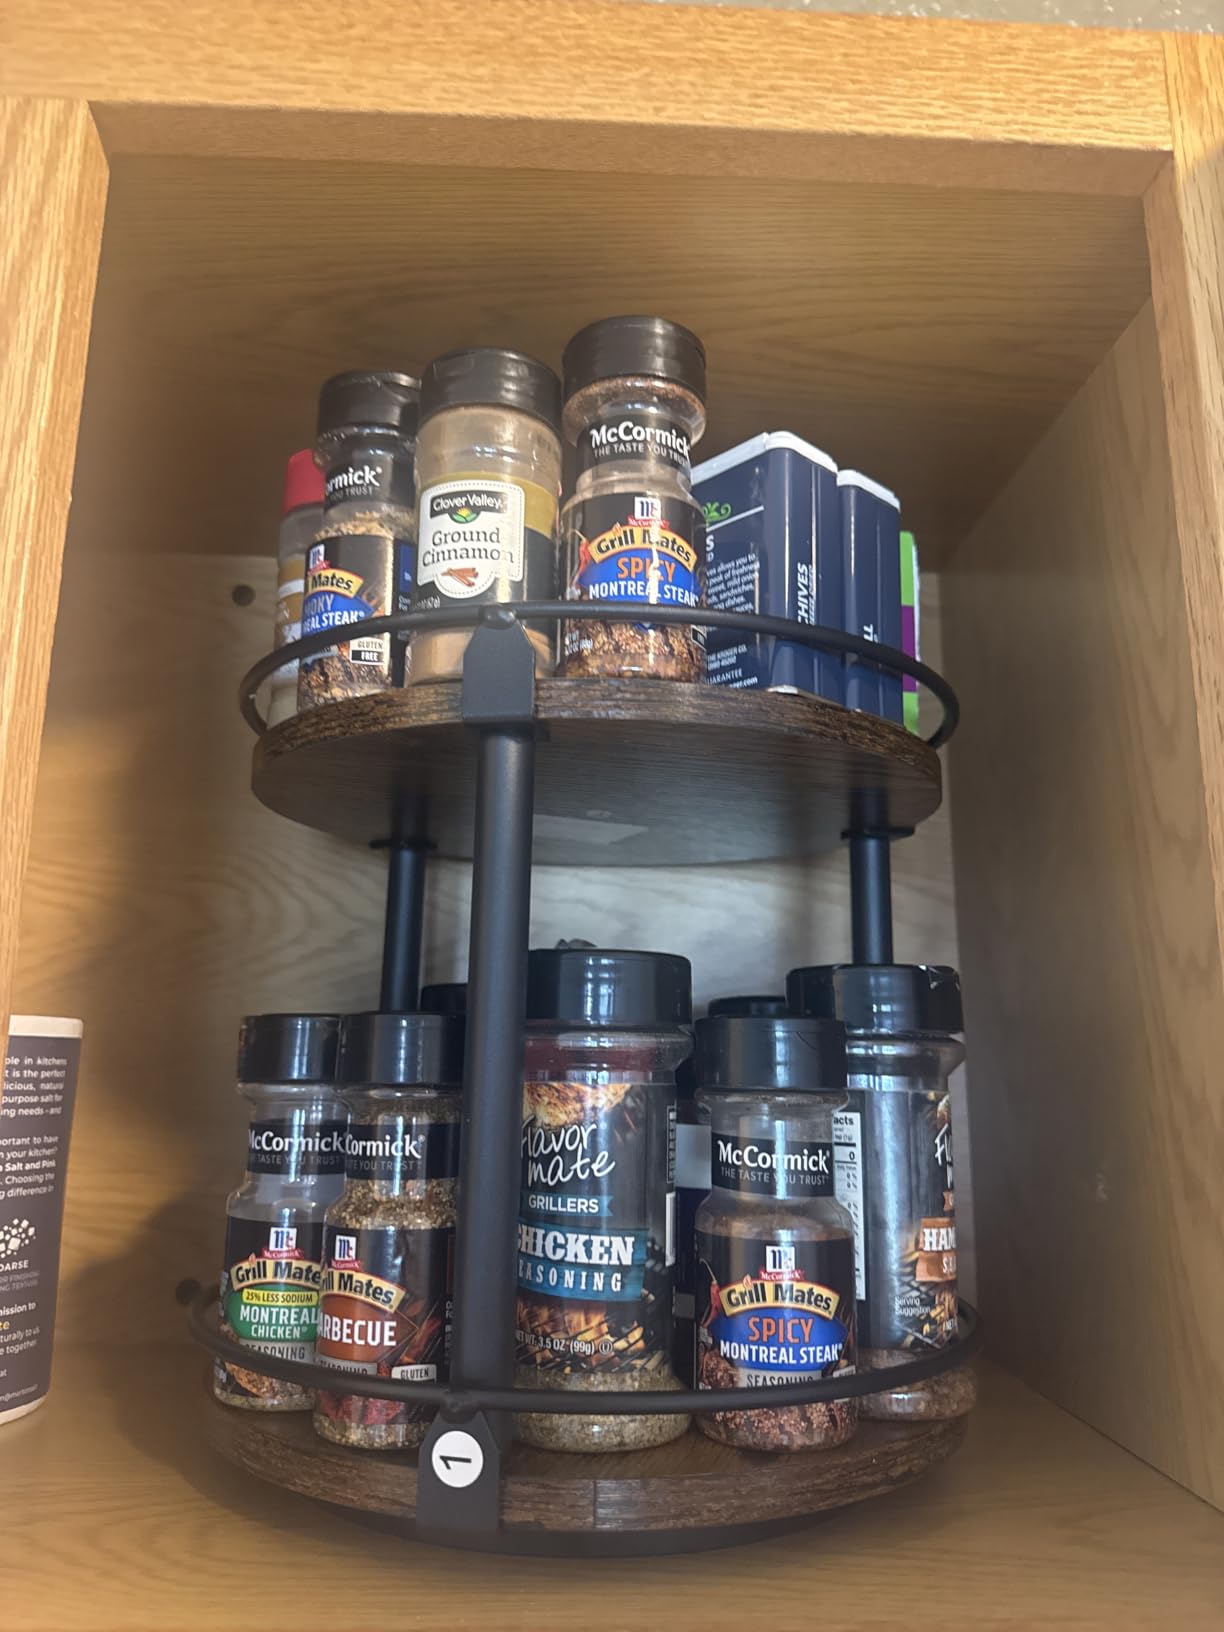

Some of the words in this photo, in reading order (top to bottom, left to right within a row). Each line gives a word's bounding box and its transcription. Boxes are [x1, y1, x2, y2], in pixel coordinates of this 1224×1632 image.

[590, 421, 691, 458] McCormick
[612, 443, 645, 453] TASTE
[433, 496, 467, 511] Clover
[468, 493, 503, 509] Valley
[432, 528, 501, 547] Ground
[597, 528, 634, 554] Grill
[642, 529, 691, 563] Mates
[421, 545, 514, 568] Cinnamon
[617, 557, 676, 583] SPICY
[312, 572, 353, 591] Mates
[589, 580, 661, 600] MONTREAL
[322, 610, 360, 628] STEAK
[361, 651, 379, 661] FREE
[24, 1056, 33, 1065] in
[13, 1068, 21, 1078] is
[23, 1069, 39, 1078] the
[2, 1095, 39, 1104] purpose
[19, 1107, 44, 1116] needs
[33, 1136, 41, 1144] to
[520, 1115, 598, 1158] Flavor
[6, 1150, 27, 1160] your
[718, 1140, 829, 1174] McCormick
[5, 1162, 23, 1171] Salt
[25, 1161, 41, 1170] and
[42, 1159, 56, 1168] Pink
[359, 1160, 377, 1170] YOU
[528, 1143, 616, 1188] mate
[5, 1173, 44, 1184] Choosing
[721, 1167, 736, 1178] THE
[738, 1168, 770, 1183] TASTE
[799, 1172, 826, 1185] TRUST
[7, 1186, 47, 1198] difference
[528, 1195, 599, 1213] GRILLERS
[235, 1260, 266, 1282] Grill
[273, 1261, 321, 1283] Mate
[519, 1259, 622, 1292] EASONING
[338, 1271, 393, 1304] Mates
[28, 1301, 36, 1311] to
[245, 1291, 261, 1301] 25%
[262, 1291, 279, 1303] LESS
[281, 1293, 313, 1303] SODIUM
[727, 1282, 767, 1307] Grill
[773, 1284, 832, 1312] Mates
[240, 1305, 318, 1325] MONTREAL
[25, 1328, 32, 1337] to
[251, 1325, 300, 1339] CHICKEN
[749, 1317, 813, 1343] SPICY
[6, 1339, 37, 1354] together
[538, 1335, 552, 1349] 3.5
[553, 1338, 565, 1351] OZ
[570, 1340, 595, 1355] (99g)
[720, 1340, 797, 1364] MONTREAL
[800, 1344, 838, 1363] STEAK
[400, 1367, 429, 1379] GLUTEN
[439, 1455, 472, 1470] 1
